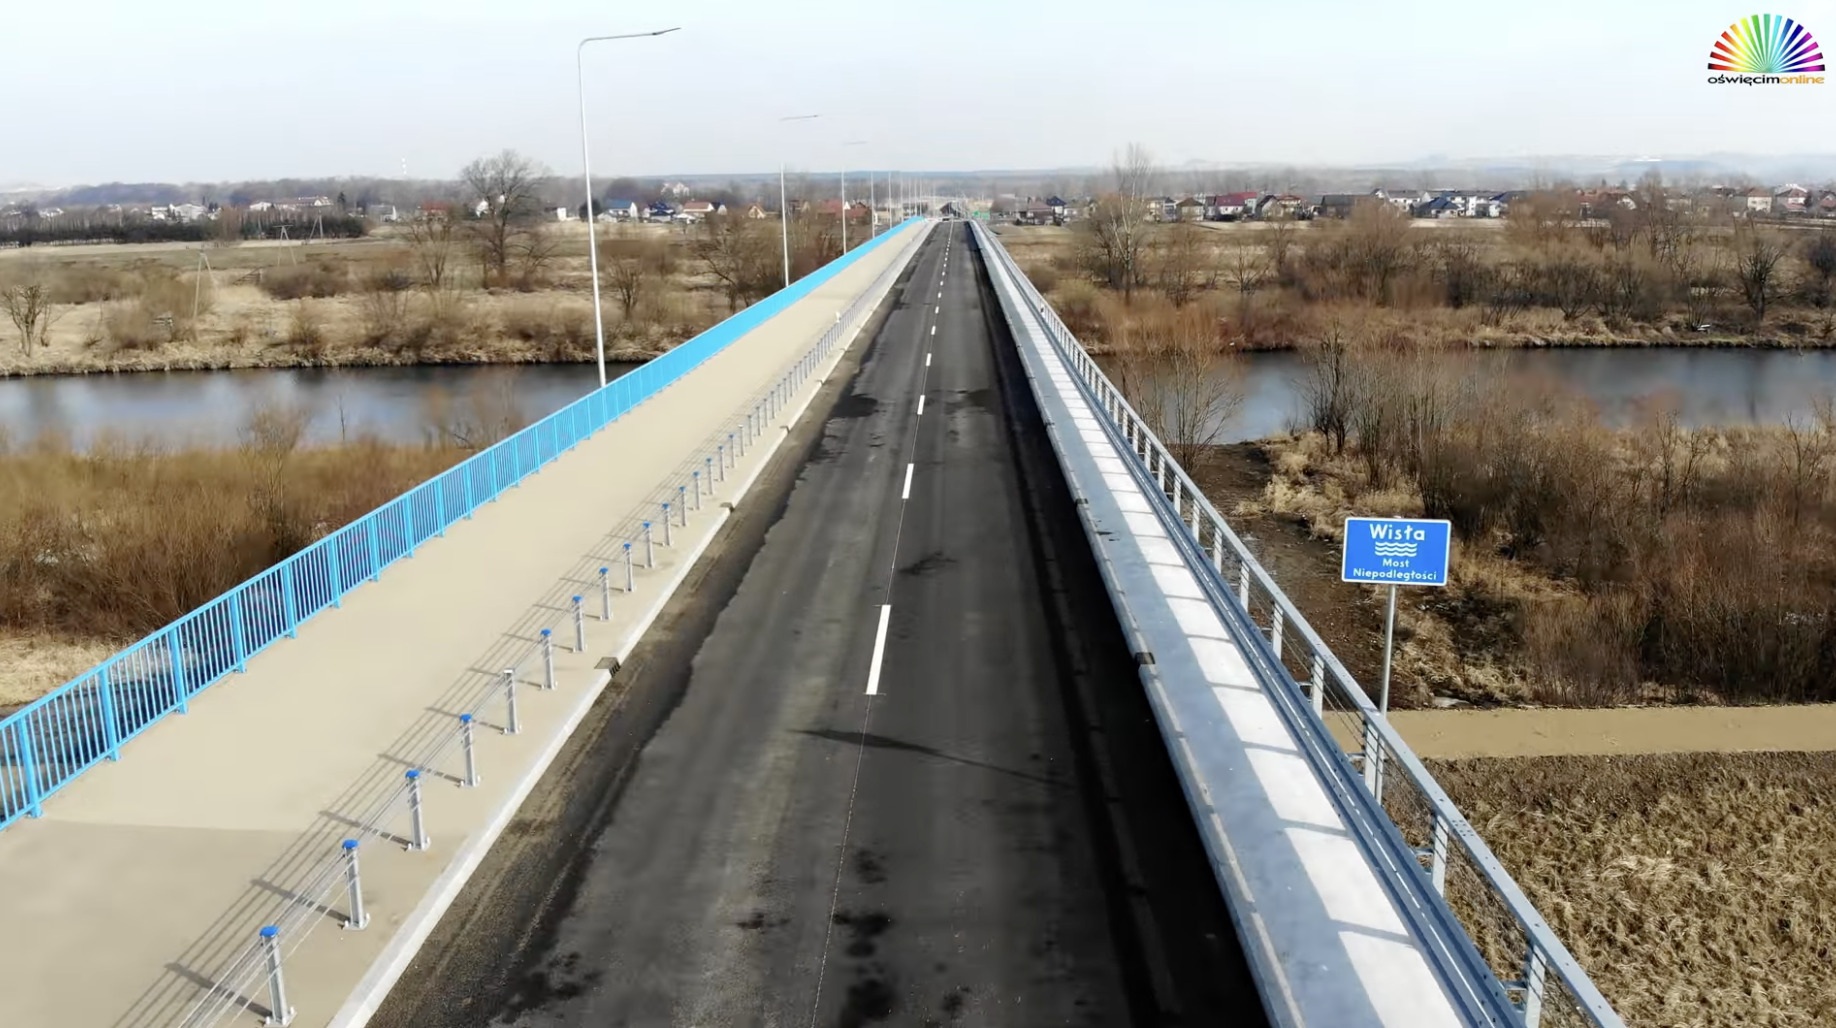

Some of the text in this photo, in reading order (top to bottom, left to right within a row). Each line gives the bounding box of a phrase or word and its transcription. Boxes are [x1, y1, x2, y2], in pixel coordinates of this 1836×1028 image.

[1370, 524, 1425, 540] Wisła
[1382, 558, 1410, 568] Most
[1353, 568, 1437, 581] Niepodległości
